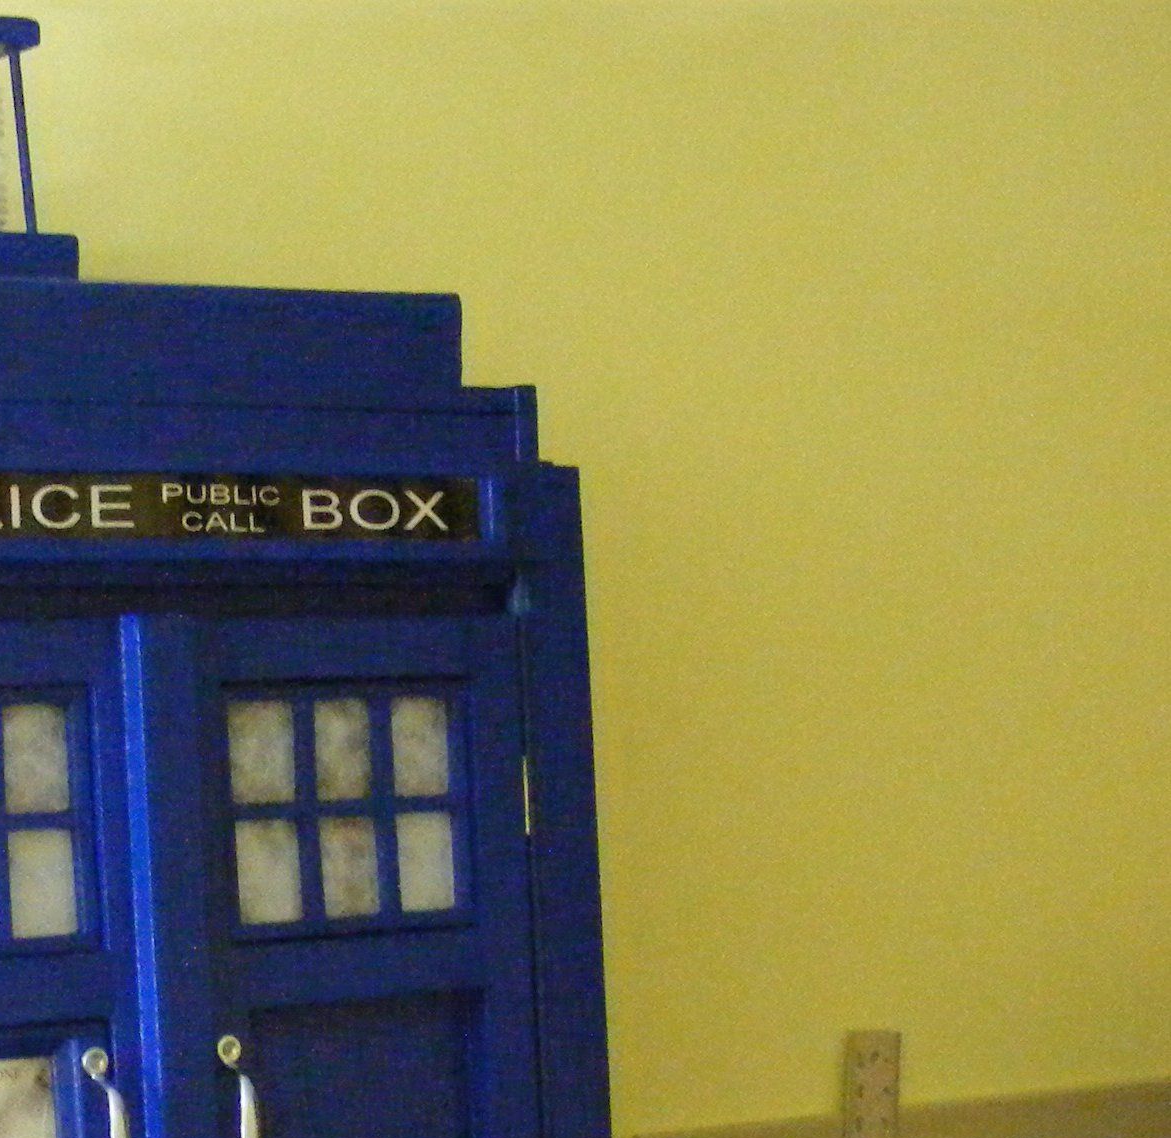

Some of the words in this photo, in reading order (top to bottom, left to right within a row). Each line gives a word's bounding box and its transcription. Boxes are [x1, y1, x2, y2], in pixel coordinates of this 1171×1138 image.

[161, 482, 280, 506] PUBLIC
[302, 488, 450, 531] BOX
[181, 511, 266, 533] CALL
